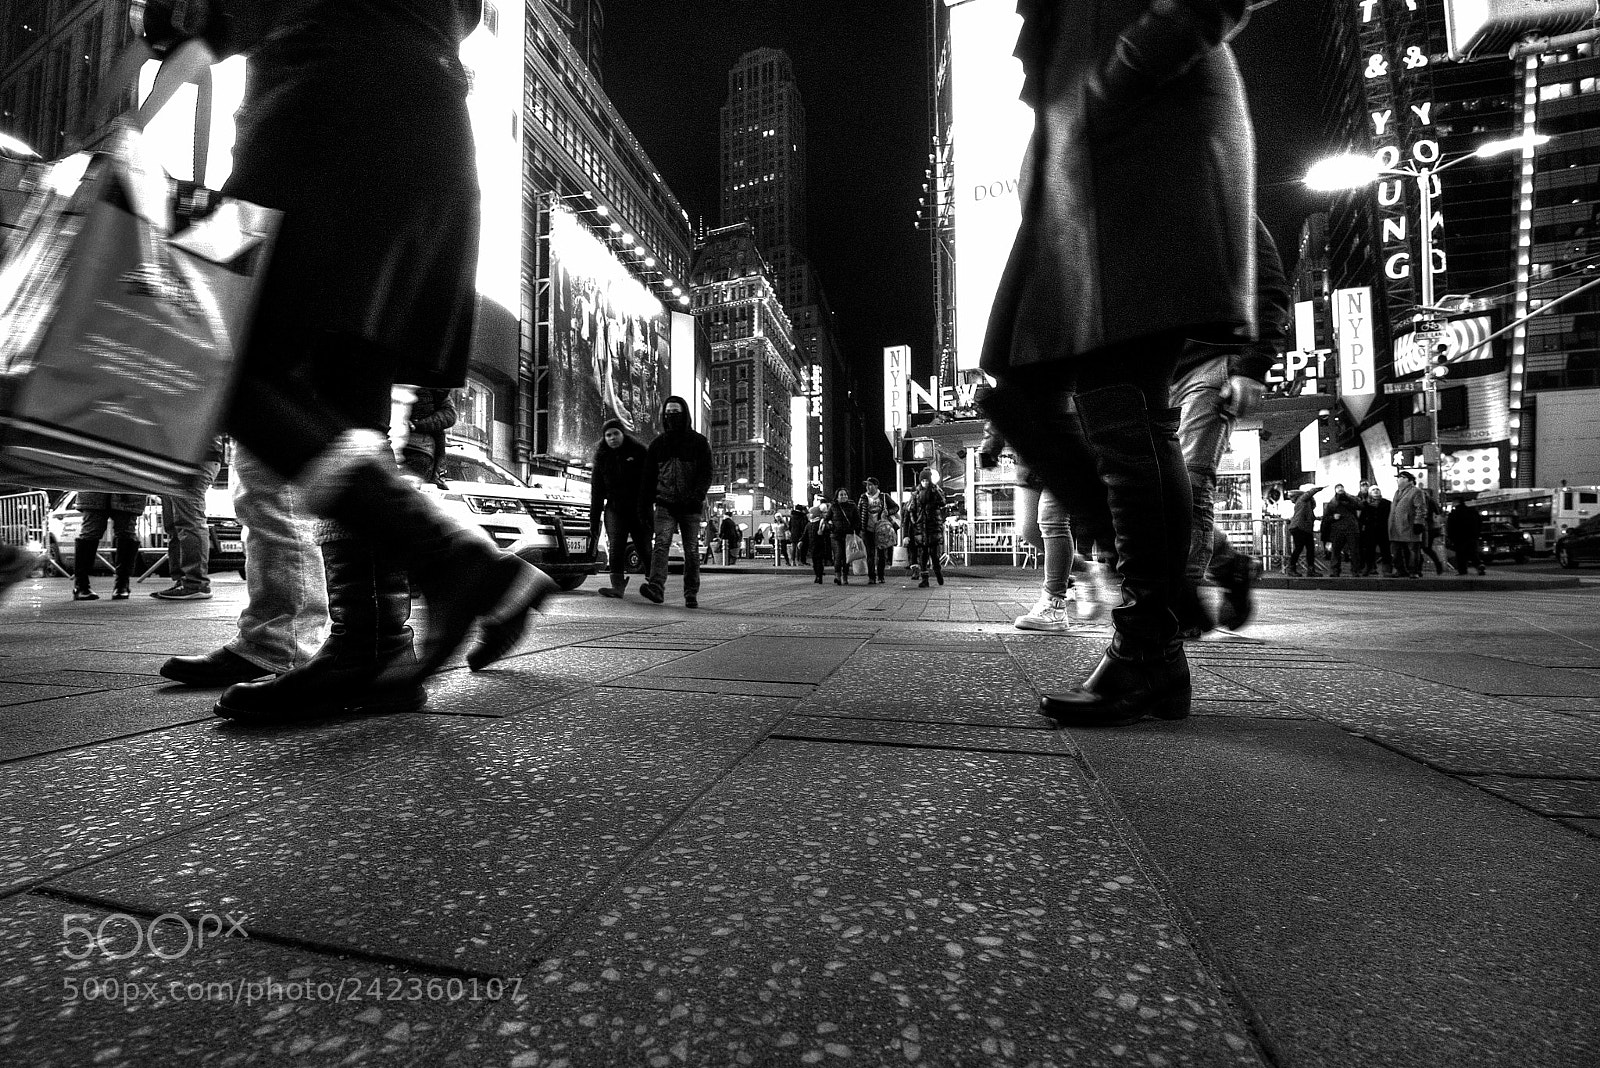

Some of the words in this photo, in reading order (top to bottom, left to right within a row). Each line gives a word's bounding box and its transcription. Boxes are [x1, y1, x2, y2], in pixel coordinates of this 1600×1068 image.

[1364, 53, 1389, 79] &
[1371, 109, 1410, 280] YOUNG
[1346, 291, 1366, 391] NYPD
[889, 349, 901, 429] NYPD
